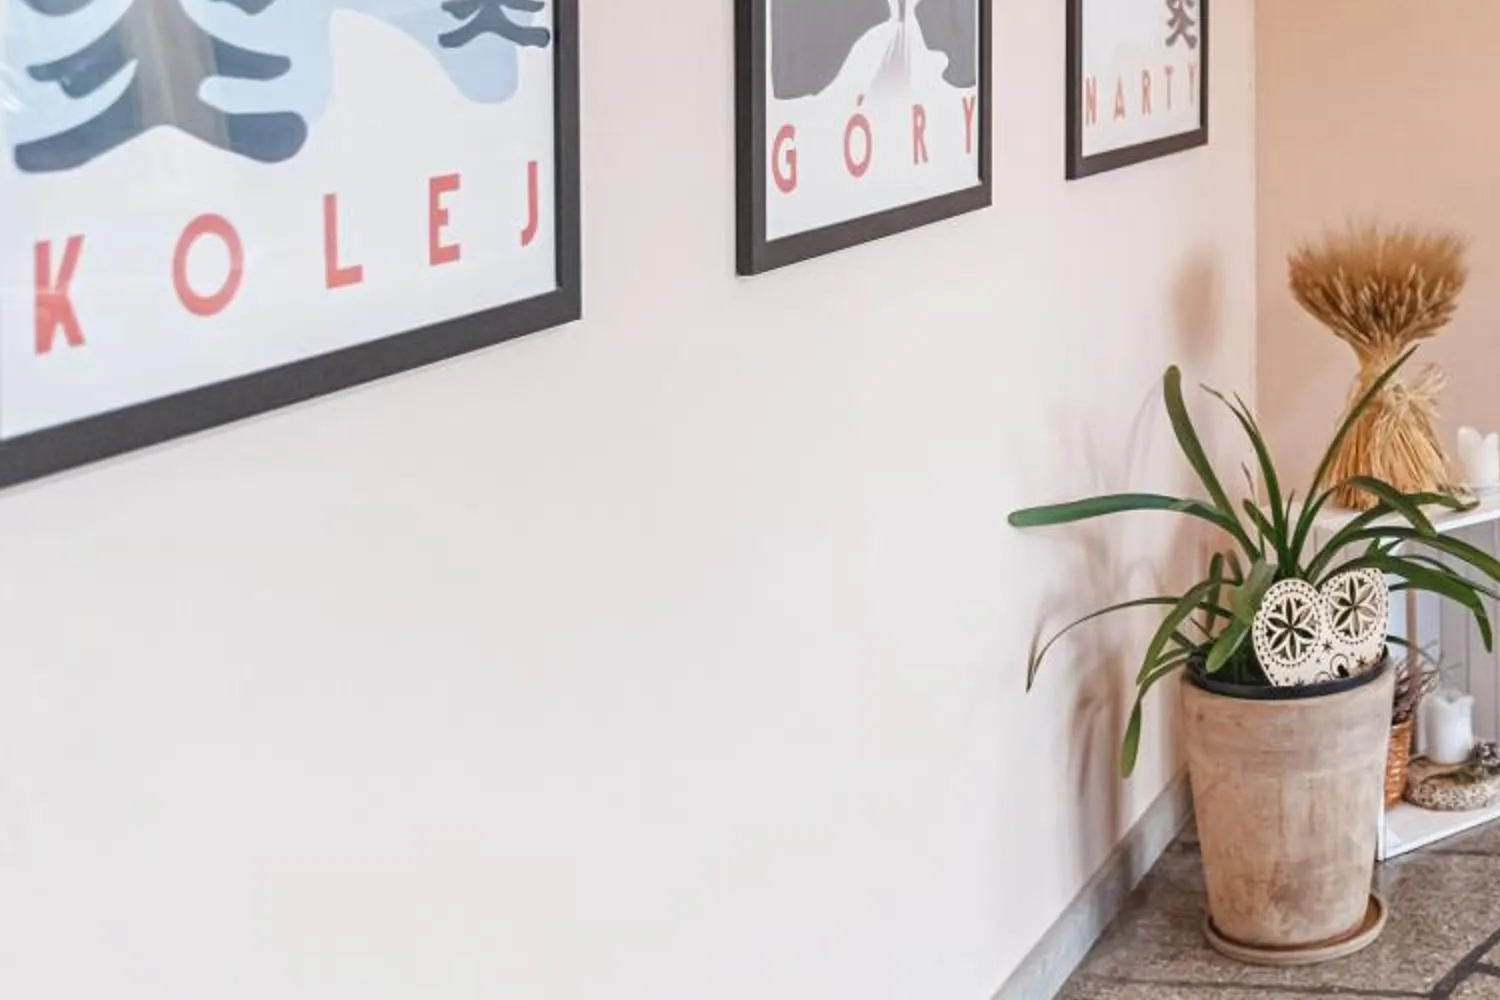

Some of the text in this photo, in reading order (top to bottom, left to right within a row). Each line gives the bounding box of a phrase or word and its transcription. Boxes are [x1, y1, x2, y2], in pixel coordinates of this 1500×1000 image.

[771, 94, 976, 193] GÓRY
[1085, 63, 1197, 126] NARTY
[34, 160, 538, 355] KOLEJ
